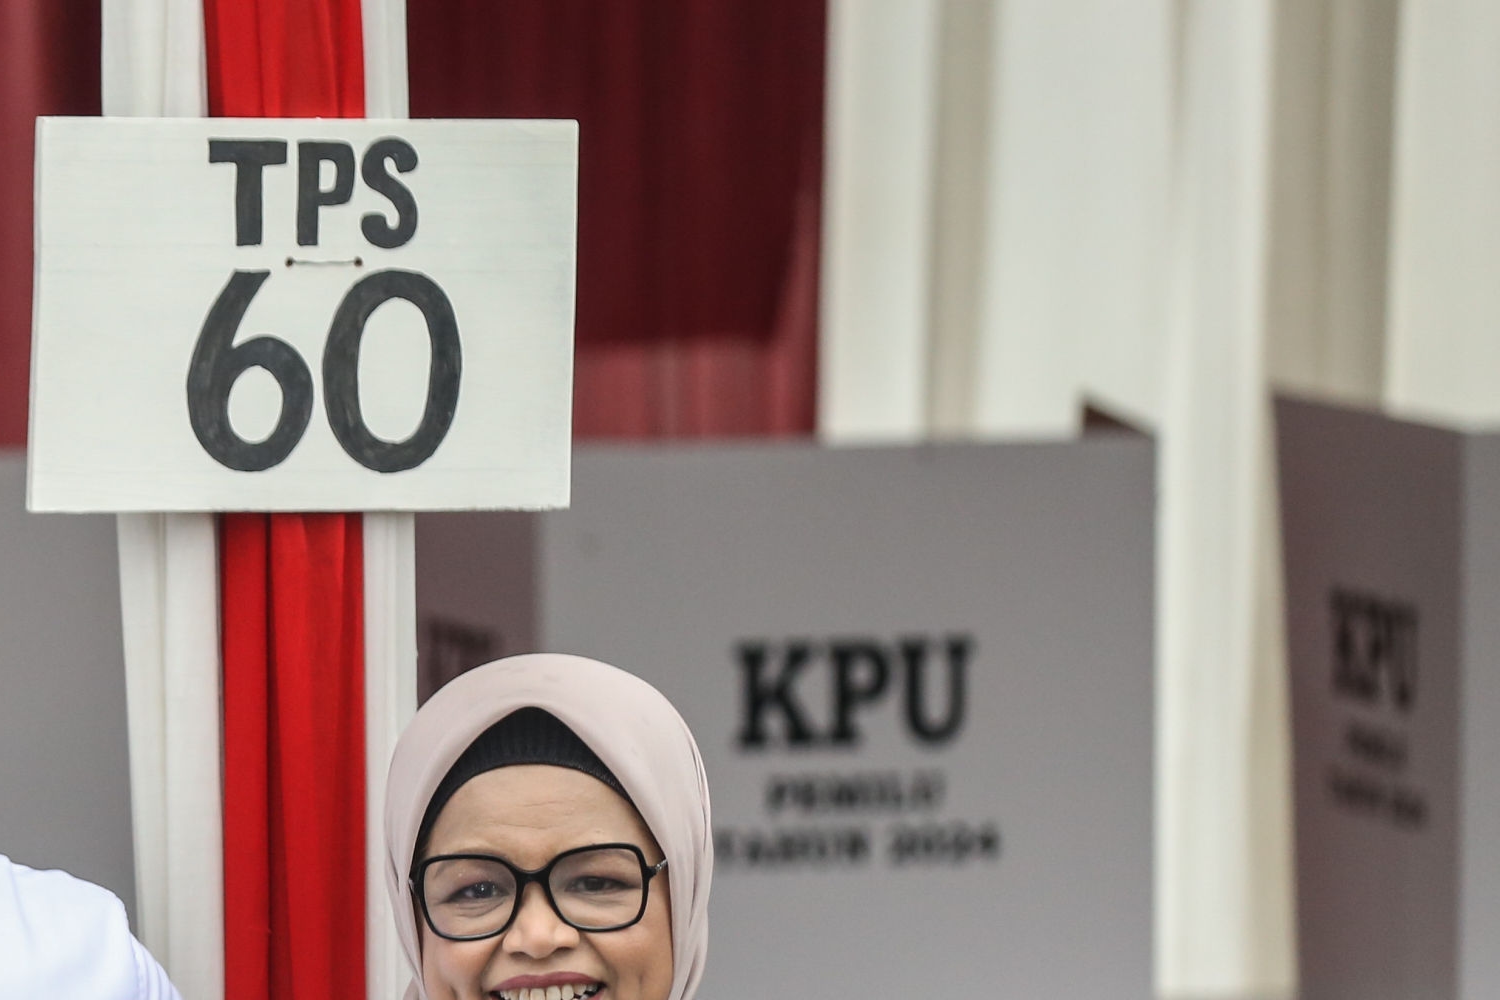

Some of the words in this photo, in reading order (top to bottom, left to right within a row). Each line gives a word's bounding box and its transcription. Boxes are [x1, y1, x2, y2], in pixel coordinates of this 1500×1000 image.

[208, 136, 418, 249] TPS
[187, 268, 462, 473] 60
[734, 636, 974, 750] KPU
